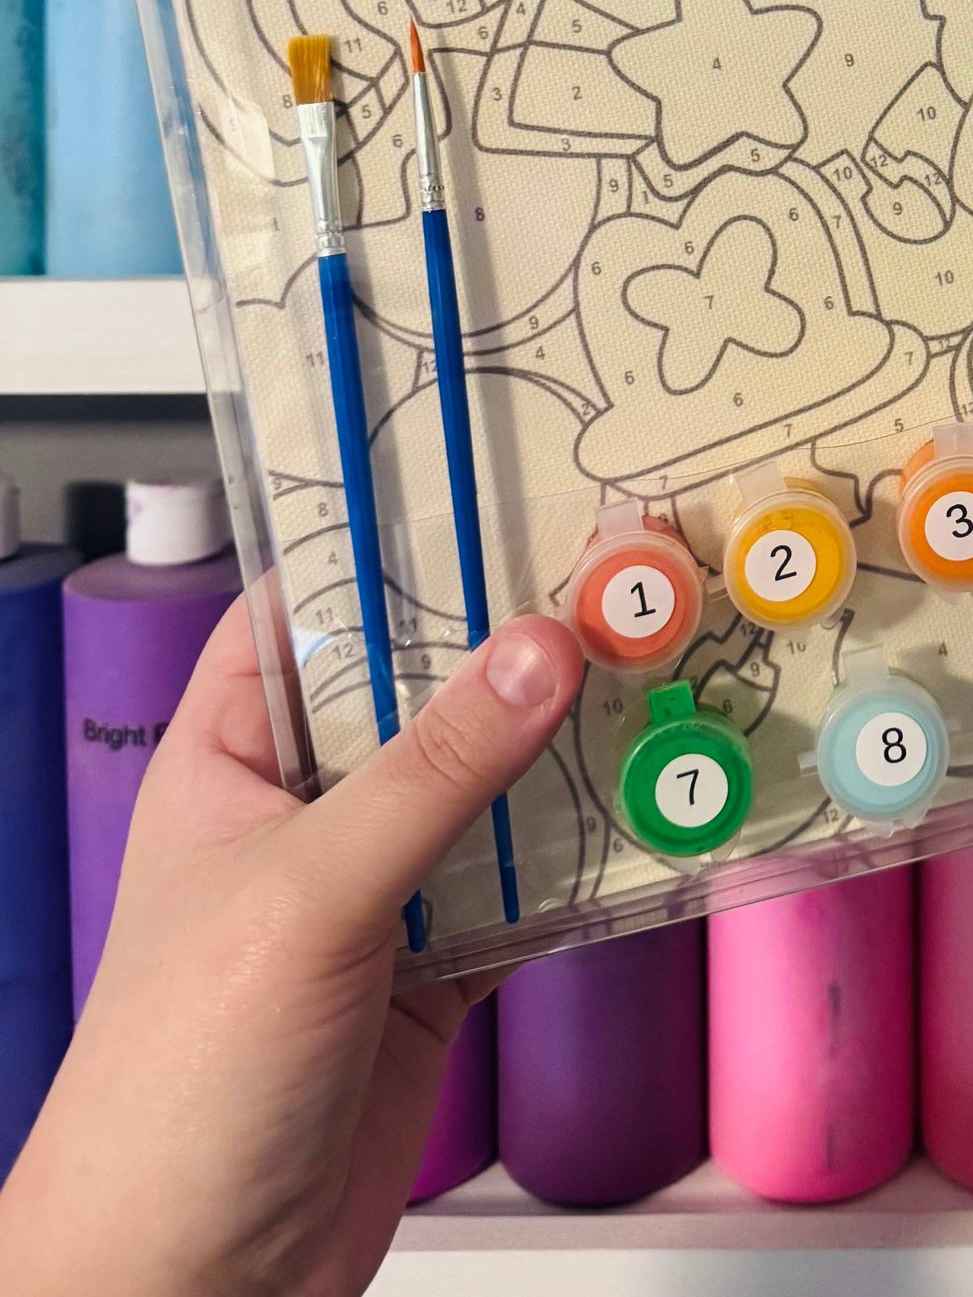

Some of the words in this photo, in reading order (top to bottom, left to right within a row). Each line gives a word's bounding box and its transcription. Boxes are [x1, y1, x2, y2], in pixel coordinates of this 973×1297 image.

[377, 1, 388, 15] 6
[516, 2, 526, 15] 4
[477, 26, 489, 40] 6
[572, 19, 582, 33] 5
[344, 38, 362, 53] 11
[712, 57, 722, 70] 4
[845, 54, 854, 67] 9
[492, 87, 502, 101] 3
[572, 86, 582, 100] 2
[361, 104, 372, 119] 5
[918, 106, 936, 121] 10
[392, 134, 403, 148] 6
[751, 148, 760, 163] 5
[834, 166, 852, 181] 10
[609, 179, 619, 193] 9
[663, 174, 673, 188] 5
[474, 206, 485, 223] 8
[789, 208, 799, 221] 6
[893, 202, 903, 215] 9
[833, 215, 841, 228] 7
[684, 241, 694, 255] 6
[591, 261, 602, 275] 6
[936, 270, 954, 286] 10
[704, 295, 714, 309] 7
[824, 296, 834, 310] 6
[529, 316, 539, 330] 9
[306, 352, 324, 367] 11
[535, 346, 545, 359] 4
[905, 351, 914, 365] 7
[625, 370, 635, 385] 6
[733, 392, 744, 407] 6
[784, 423, 792, 437] 7
[895, 418, 904, 433] 5
[659, 475, 668, 490] 7
[318, 502, 329, 517] 8
[947, 504, 973, 538] 3
[771, 545, 796, 581] 2
[631, 582, 656, 617] 1
[83, 718, 147, 750] Bright
[882, 728, 906, 763] 8
[677, 769, 699, 805] 7
